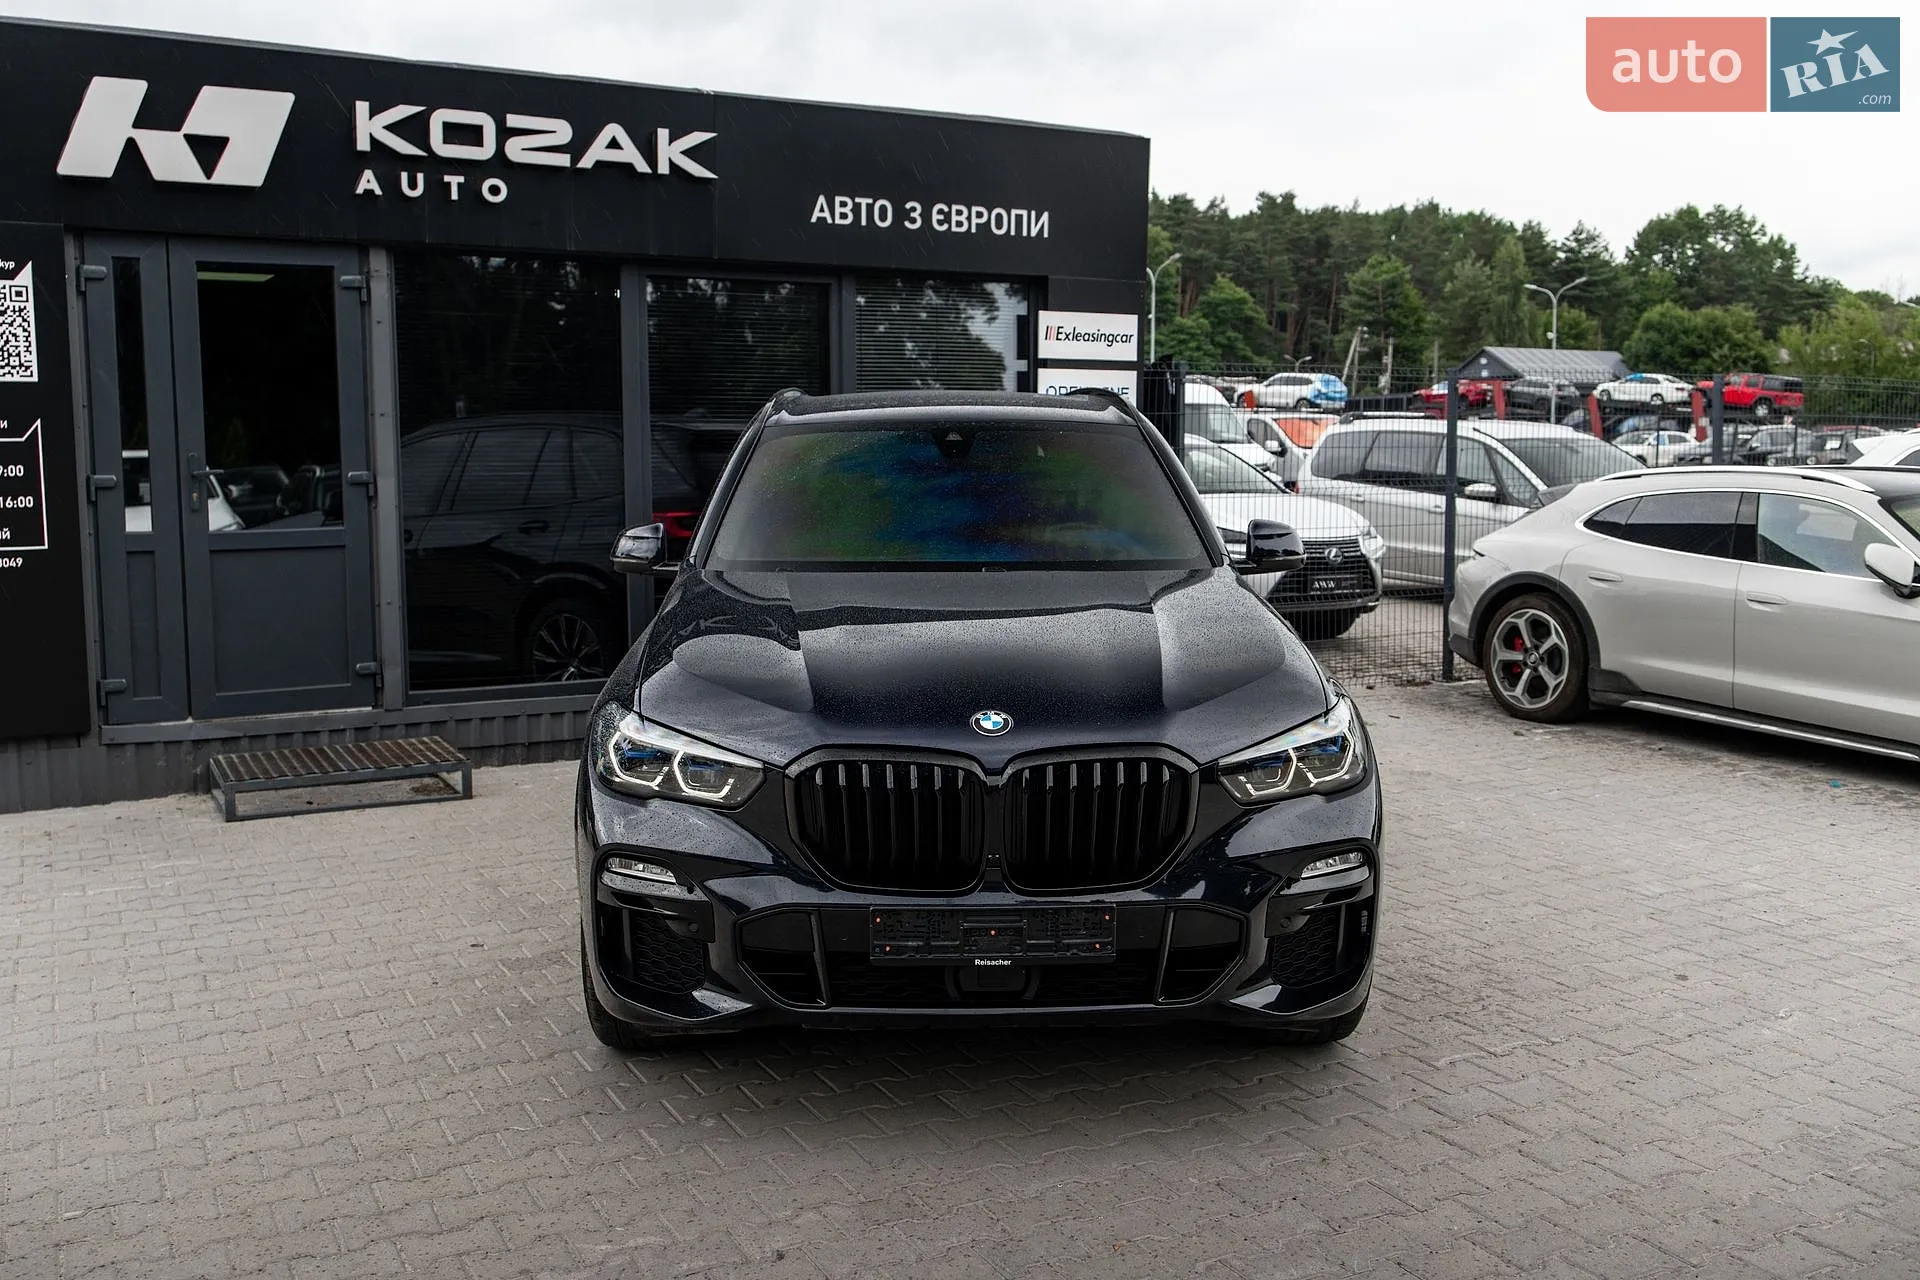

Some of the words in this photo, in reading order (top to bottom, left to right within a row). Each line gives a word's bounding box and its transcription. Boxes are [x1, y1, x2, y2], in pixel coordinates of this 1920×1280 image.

[355, 169, 508, 204] AUTO
[810, 194, 893, 228] АВТО
[931, 203, 1050, 239] ЄВРОПИ
[1055, 325, 1134, 348] Exleasingcar
[974, 958, 1012, 966] Reisacher
